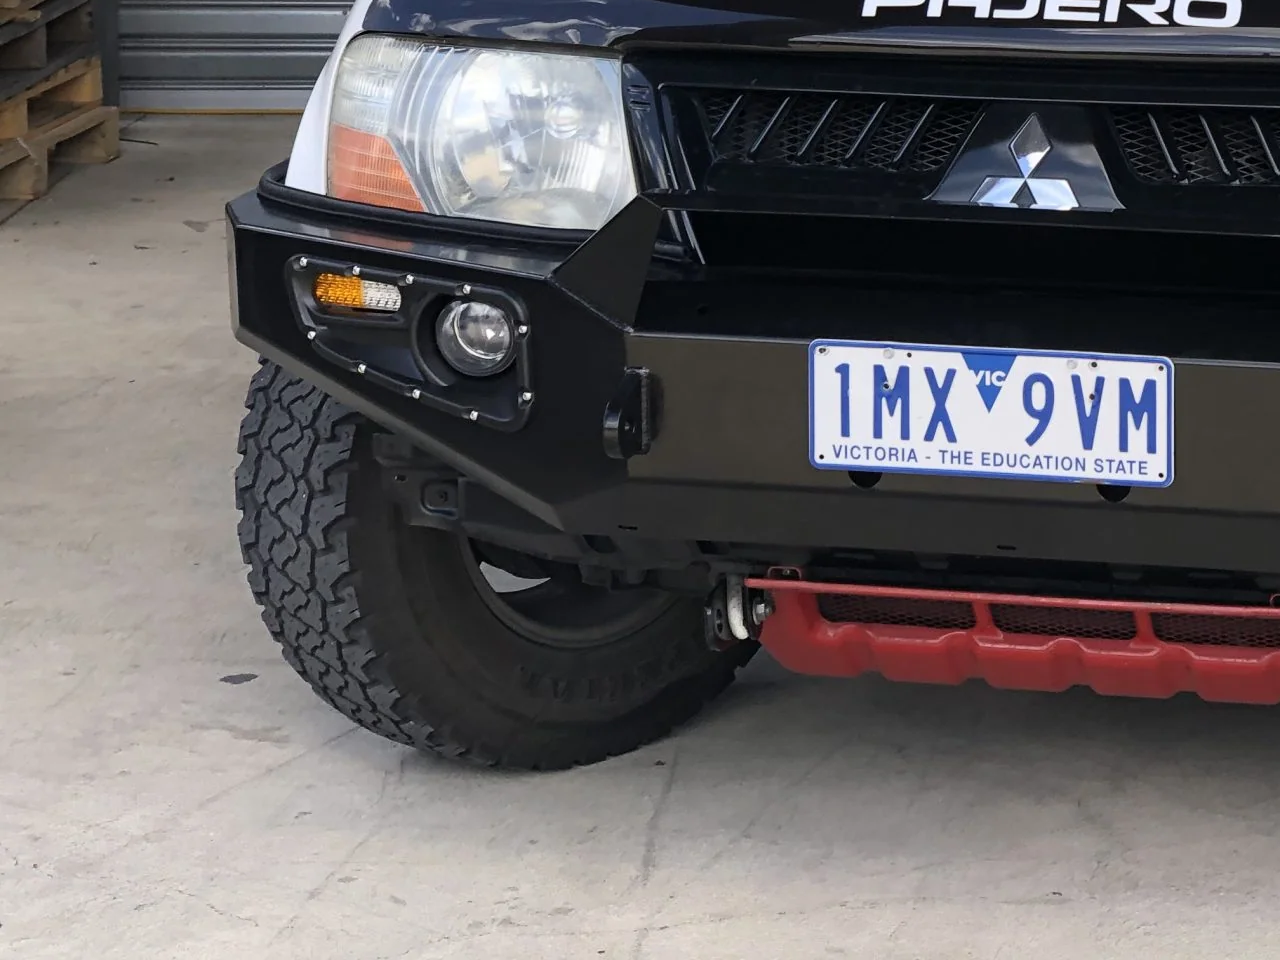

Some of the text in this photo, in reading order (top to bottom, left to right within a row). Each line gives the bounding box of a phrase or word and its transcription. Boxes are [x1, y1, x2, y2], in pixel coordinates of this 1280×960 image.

[832, 444, 918, 463] VICTORIA
[939, 450, 974, 465] THE
[981, 453, 1086, 472] EDUCATION
[1094, 458, 1149, 475] STATE
